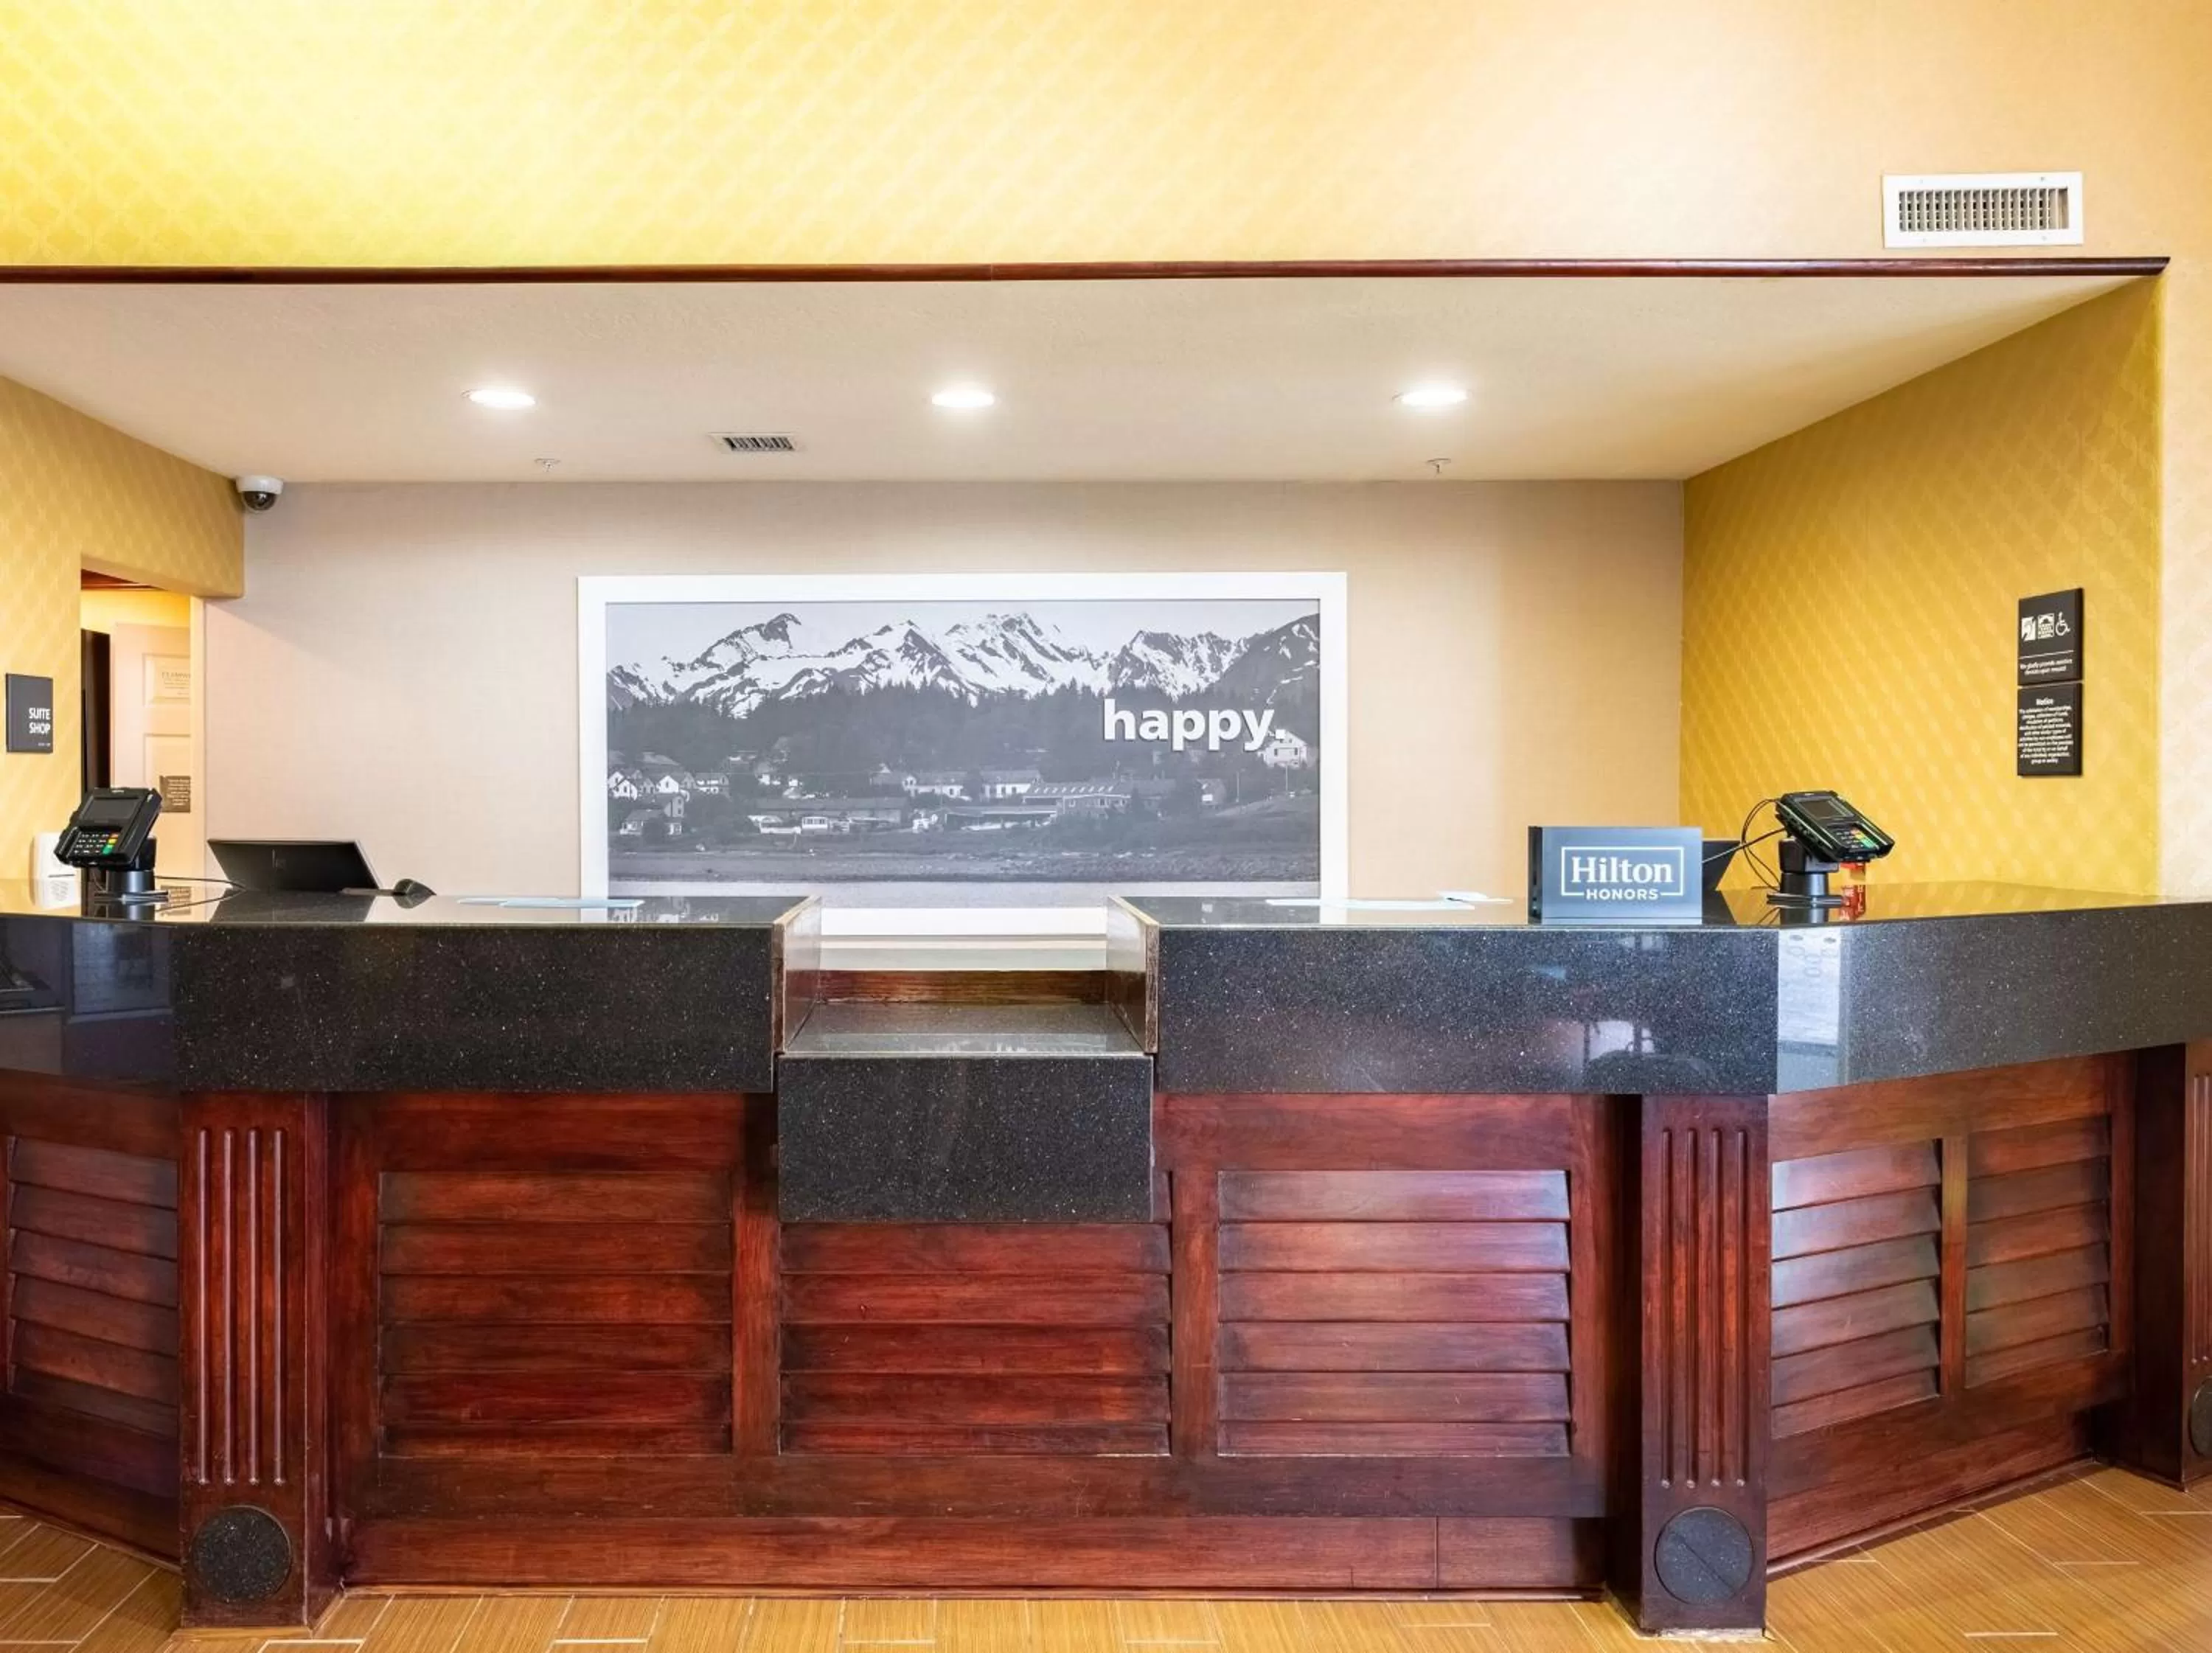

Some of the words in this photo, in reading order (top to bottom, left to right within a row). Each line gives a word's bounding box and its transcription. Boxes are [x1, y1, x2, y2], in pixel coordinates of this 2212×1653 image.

[29, 707, 51, 720] SUITE
[29, 722, 51, 735] SHOP
[1104, 698, 1287, 752] happy.
[1571, 856, 1675, 884] Hilton
[1586, 888, 1659, 900] HONORS
